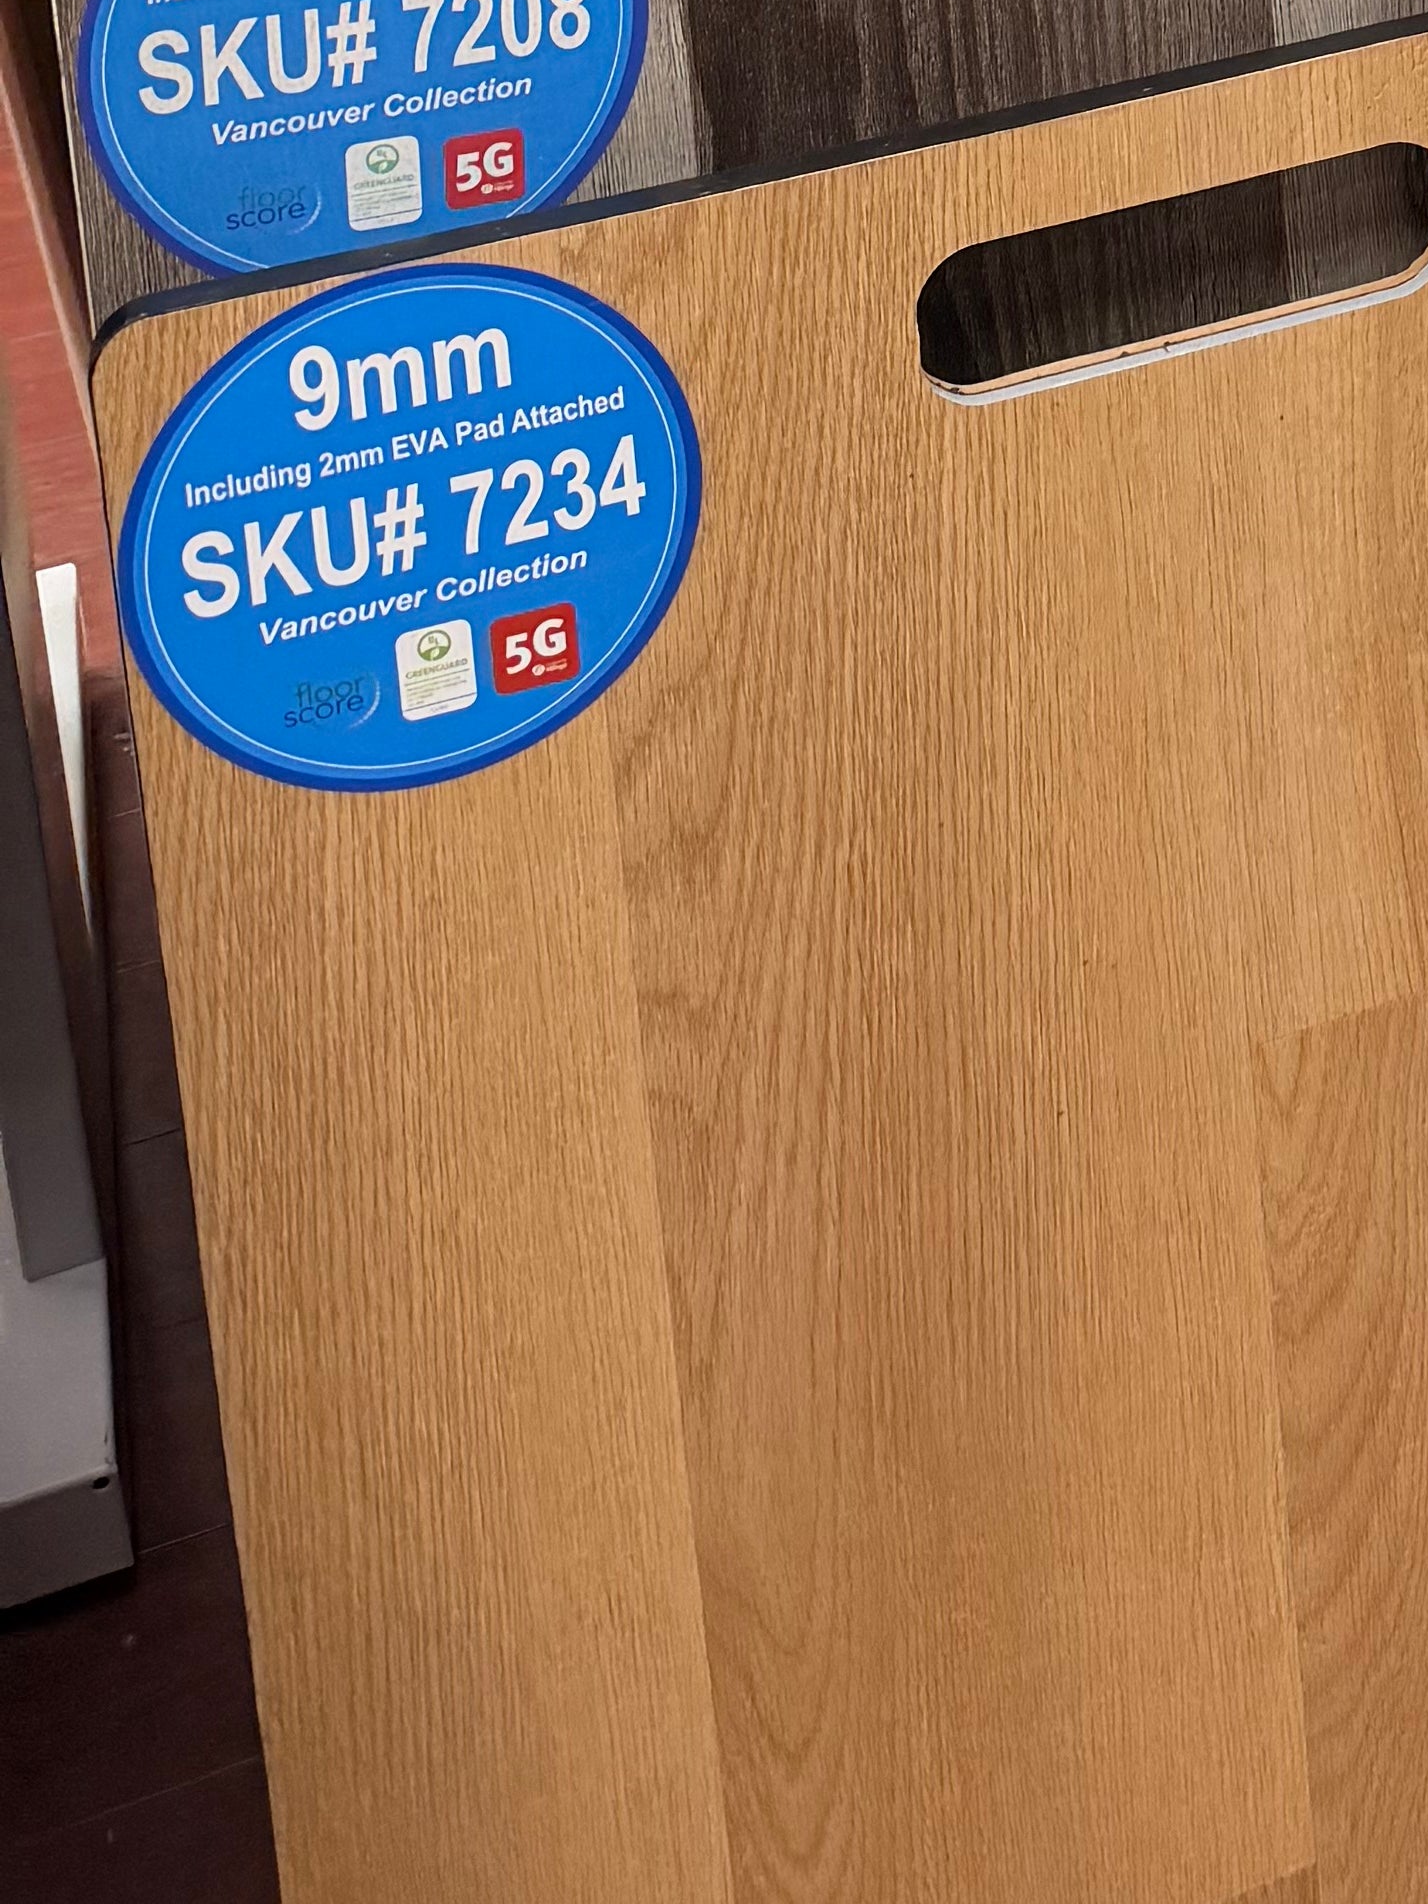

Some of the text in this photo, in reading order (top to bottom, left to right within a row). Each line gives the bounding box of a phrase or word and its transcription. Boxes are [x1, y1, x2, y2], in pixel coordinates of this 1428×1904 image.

[456, 141, 514, 192] 5G
[289, 328, 512, 432] 9mm
[185, 385, 625, 508] Including 2mm EVA Pad Attached
[181, 434, 647, 619] SKU# 7234
[259, 550, 588, 645] Vancouver Collection
[505, 618, 567, 675] 5G
